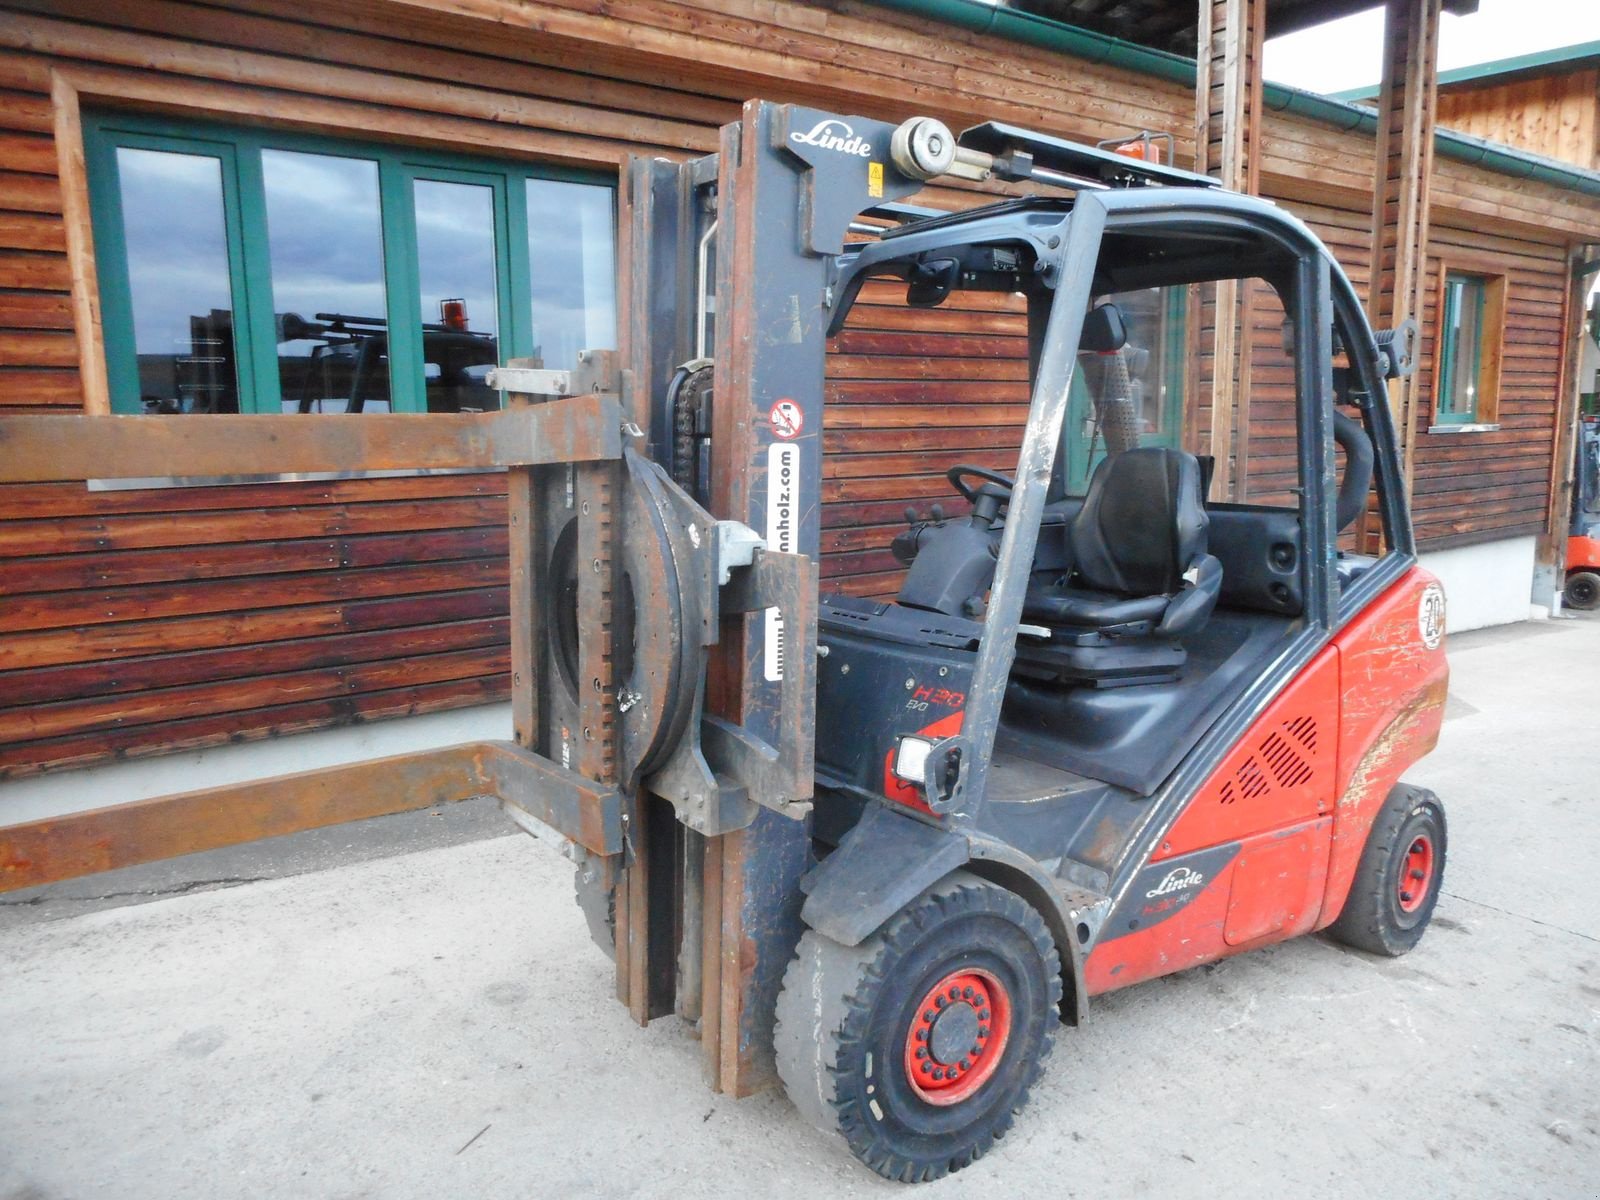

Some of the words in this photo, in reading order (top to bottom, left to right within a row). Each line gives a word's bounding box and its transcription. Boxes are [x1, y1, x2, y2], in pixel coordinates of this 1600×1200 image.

[790, 119, 871, 158] Linde
[776, 450, 791, 552] nnholz.com
[905, 699, 929, 712] EVO
[1146, 867, 1203, 898] Linde
